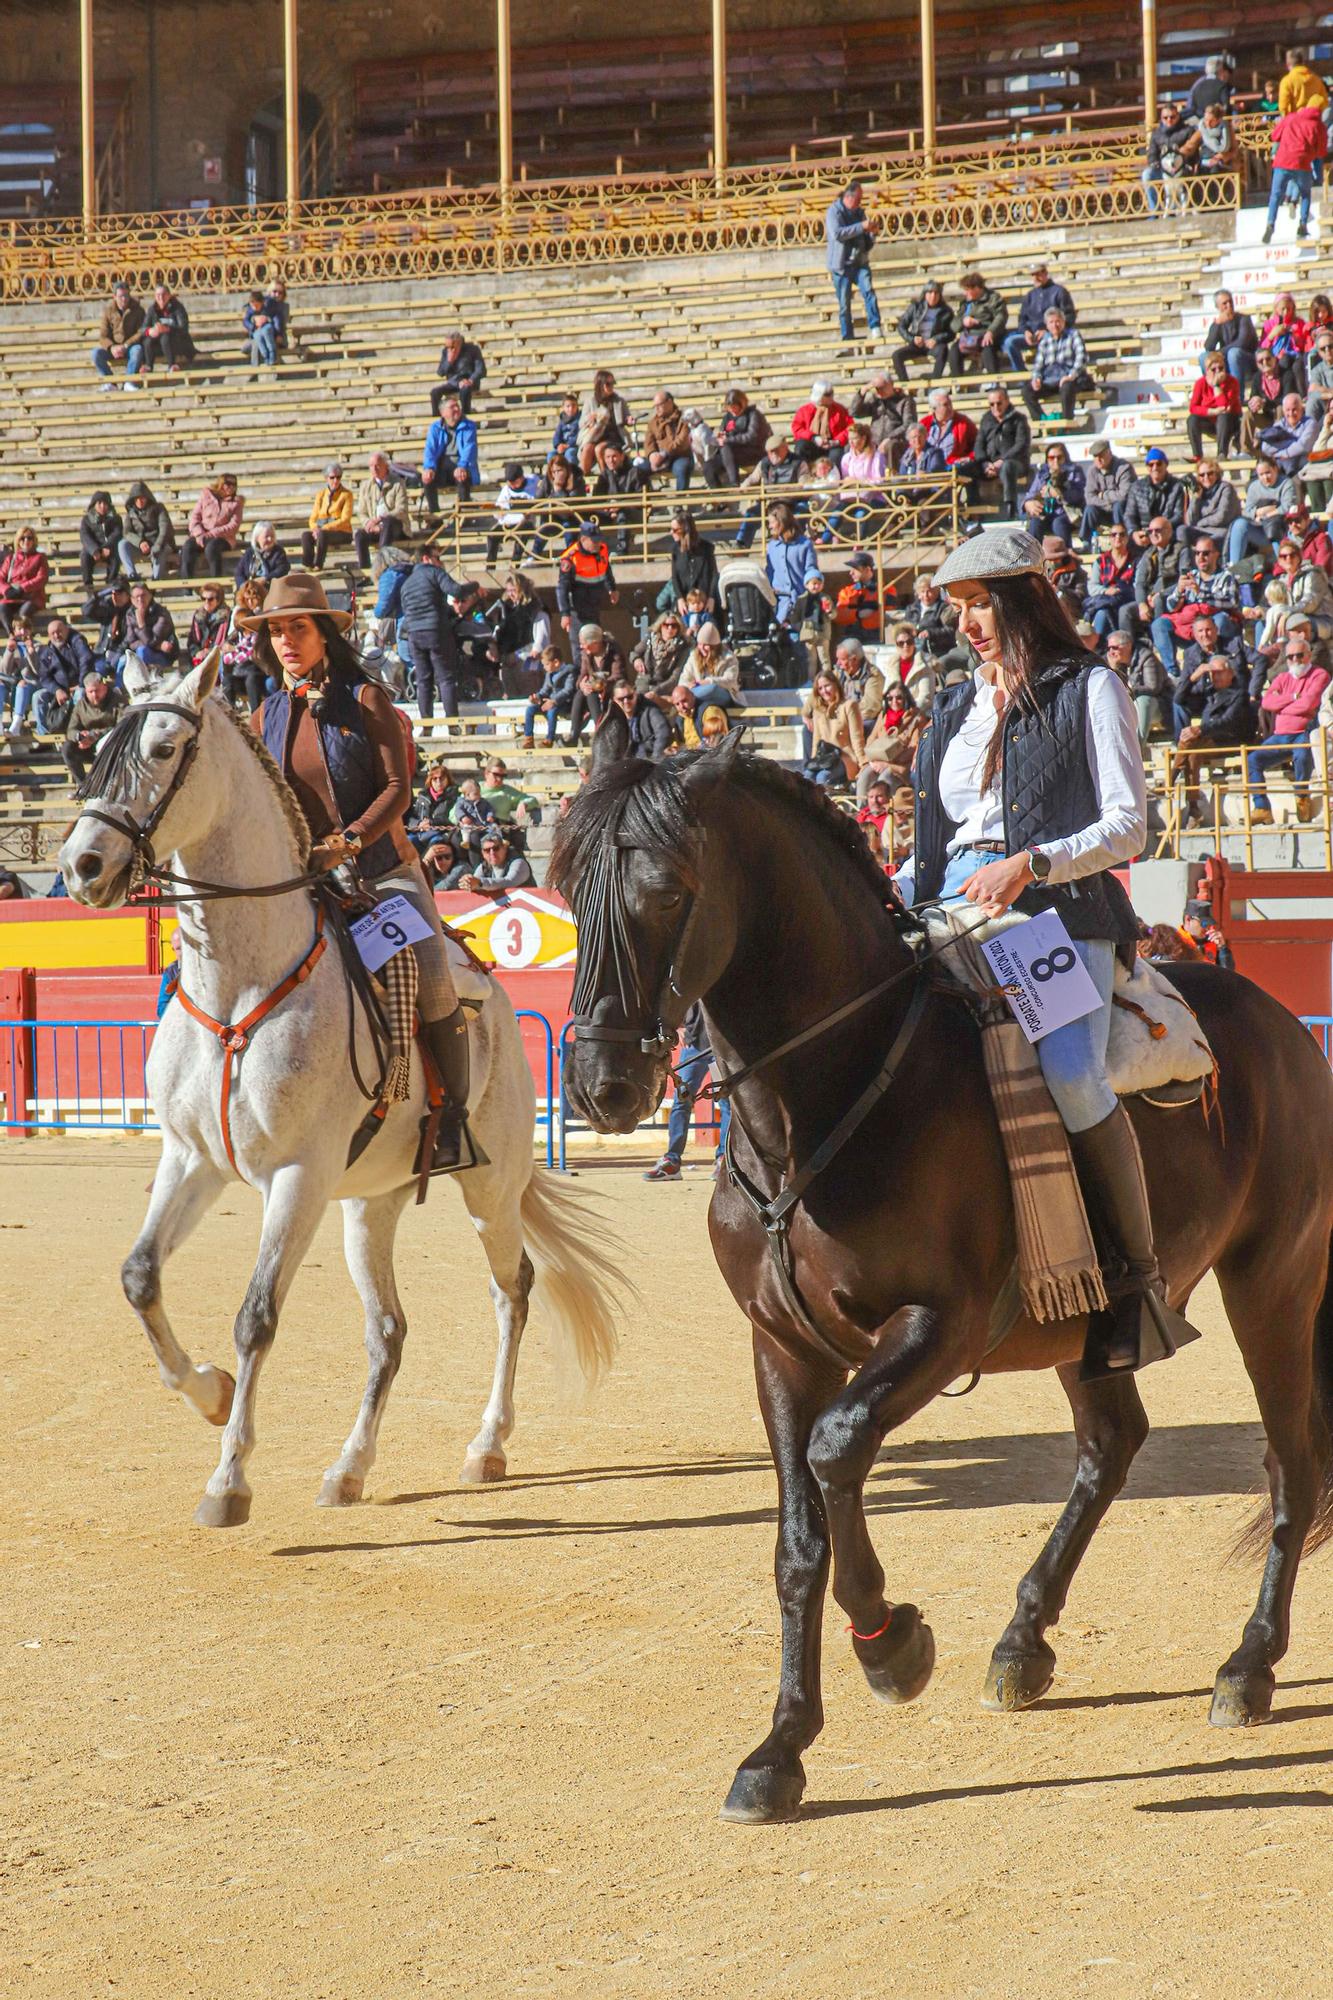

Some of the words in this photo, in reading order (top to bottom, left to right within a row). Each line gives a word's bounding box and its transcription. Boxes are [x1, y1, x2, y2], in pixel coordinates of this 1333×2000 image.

[381, 921, 408, 947] 9
[506, 918, 523, 957] 3
[988, 940, 1005, 957] 2023
[1010, 950, 1029, 978] ECUESTRE
[1030, 946, 1077, 982] 8
[1023, 977, 1044, 1008] CONCURSO
[1018, 999, 1044, 1033] PORRATE
